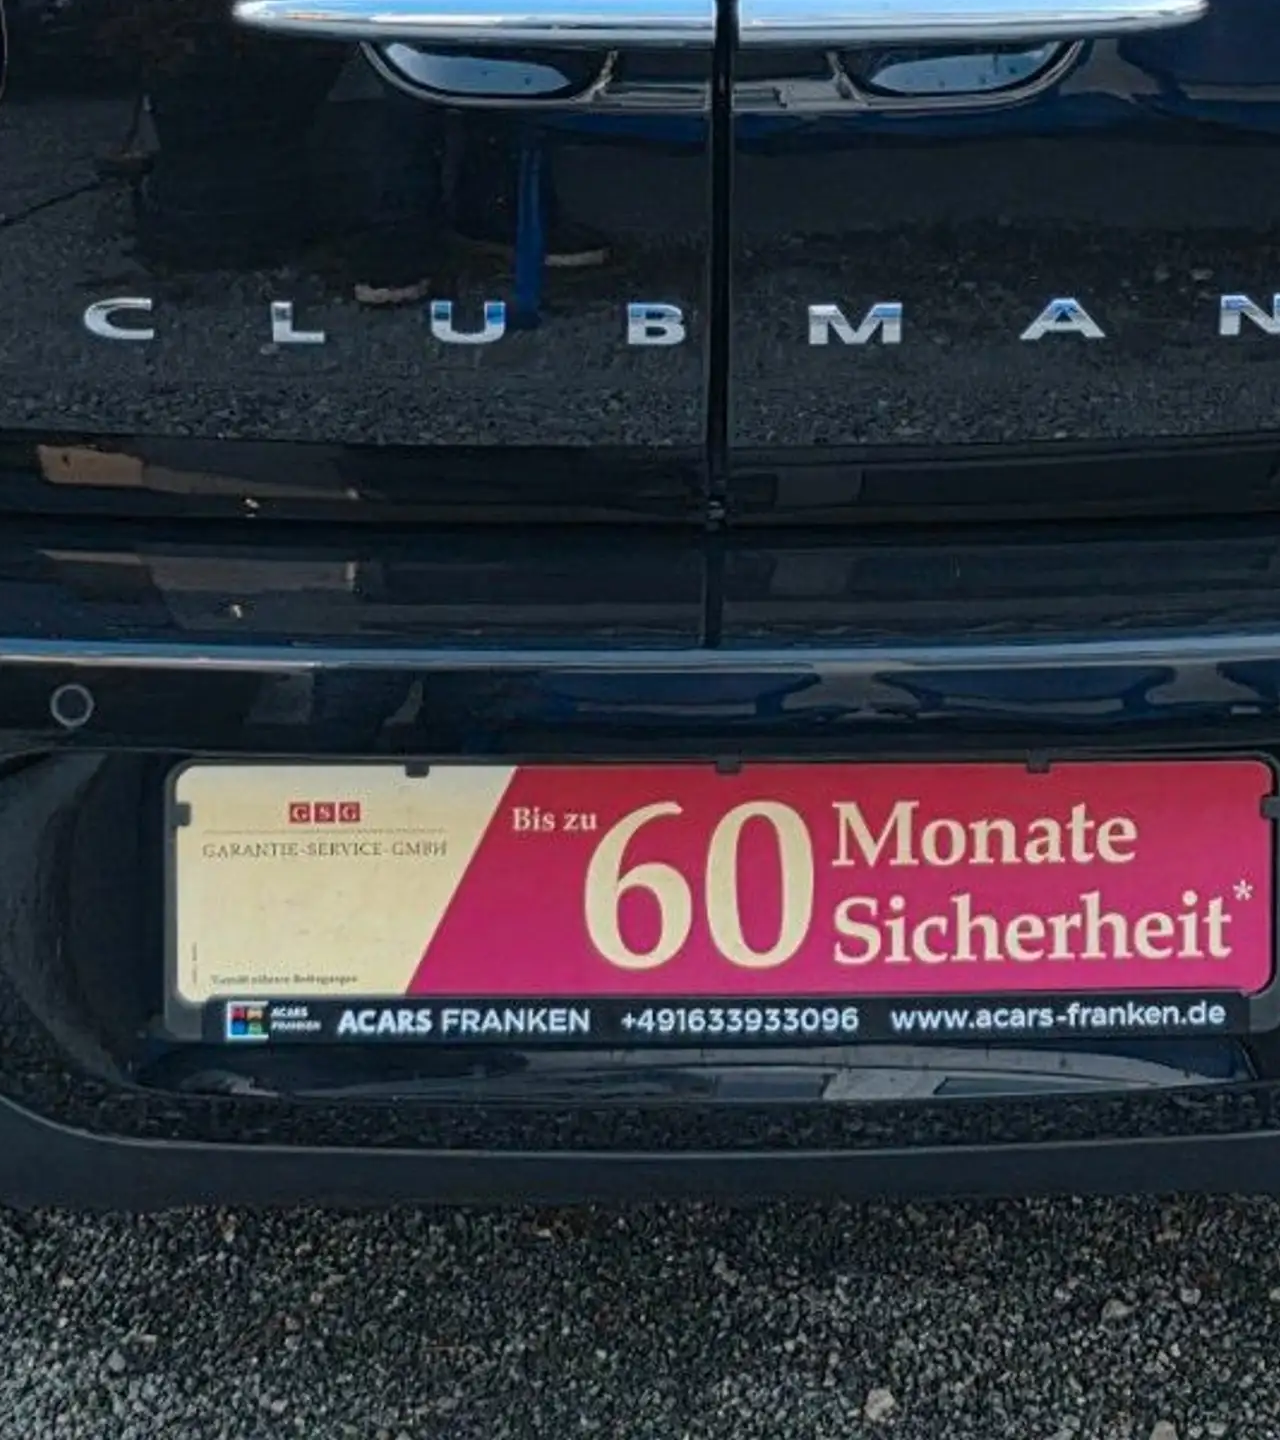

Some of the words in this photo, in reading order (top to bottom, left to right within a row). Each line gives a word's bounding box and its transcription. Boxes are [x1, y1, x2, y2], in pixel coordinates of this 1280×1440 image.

[290, 803, 360, 822] GSG
[512, 807, 556, 832] Bis
[562, 812, 599, 832] zu
[831, 800, 1138, 867] Monate
[584, 800, 815, 970] 60
[337, 1008, 433, 1034] ACARS
[442, 1007, 591, 1034] FRANKEN
[622, 1005, 859, 1034] +491633933096
[891, 1000, 1227, 1030] www.acars-franken.de
